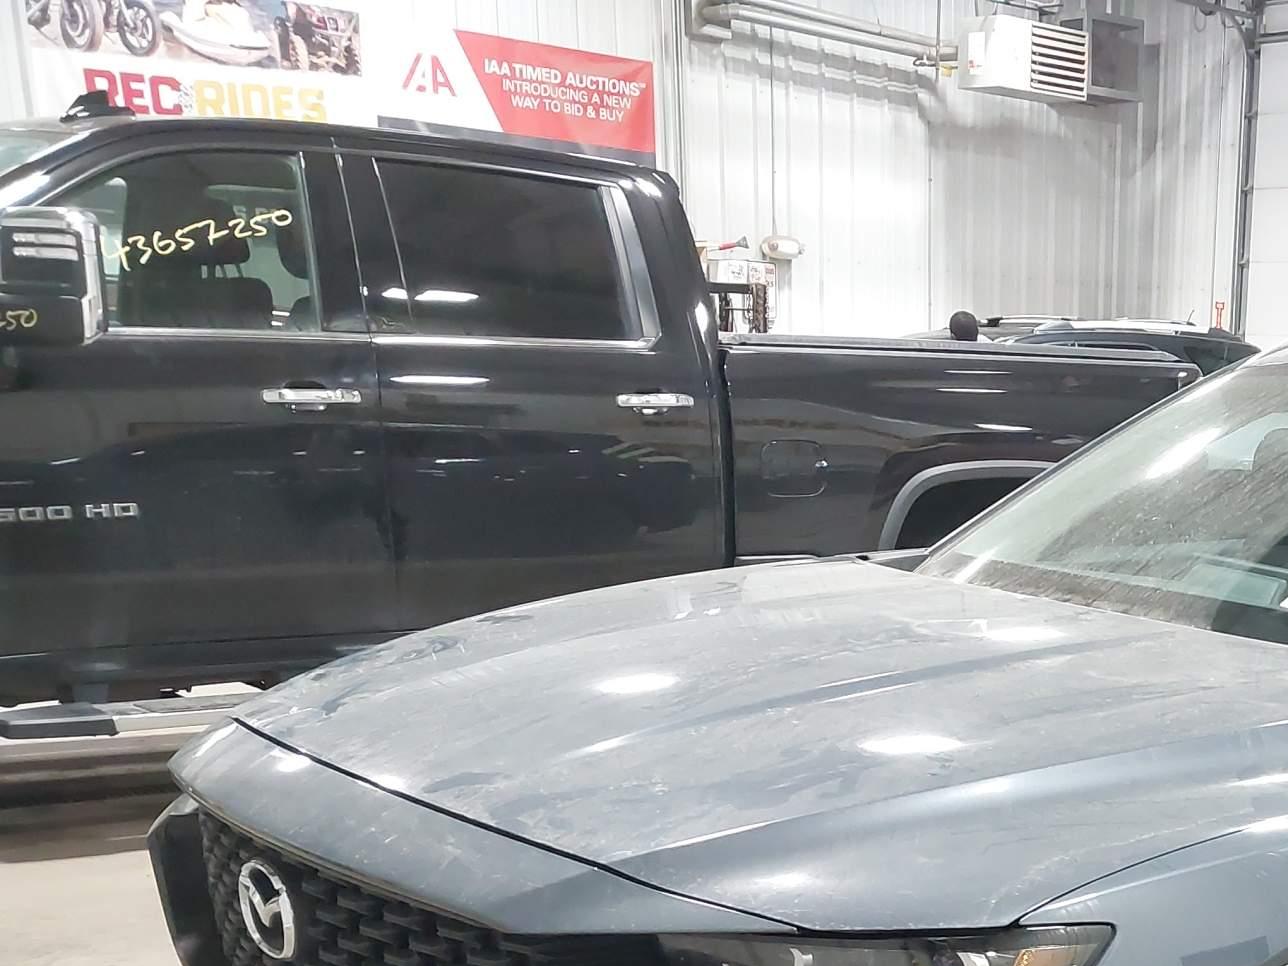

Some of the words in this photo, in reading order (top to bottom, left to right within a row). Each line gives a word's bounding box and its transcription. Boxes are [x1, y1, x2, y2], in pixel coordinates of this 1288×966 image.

[484, 58, 510, 77] IAA
[513, 63, 562, 84] TIMED
[83, 67, 183, 116] REC
[194, 79, 328, 123] RIDES
[502, 78, 588, 103] INTRODUCING
[591, 94, 601, 105] A
[603, 95, 632, 109] NEW
[511, 94, 540, 109] WAY
[542, 99, 561, 112] TO
[564, 102, 583, 117] BID
[586, 106, 596, 118] &
[599, 107, 625, 123] BUY
[85, 502, 139, 518] HD
